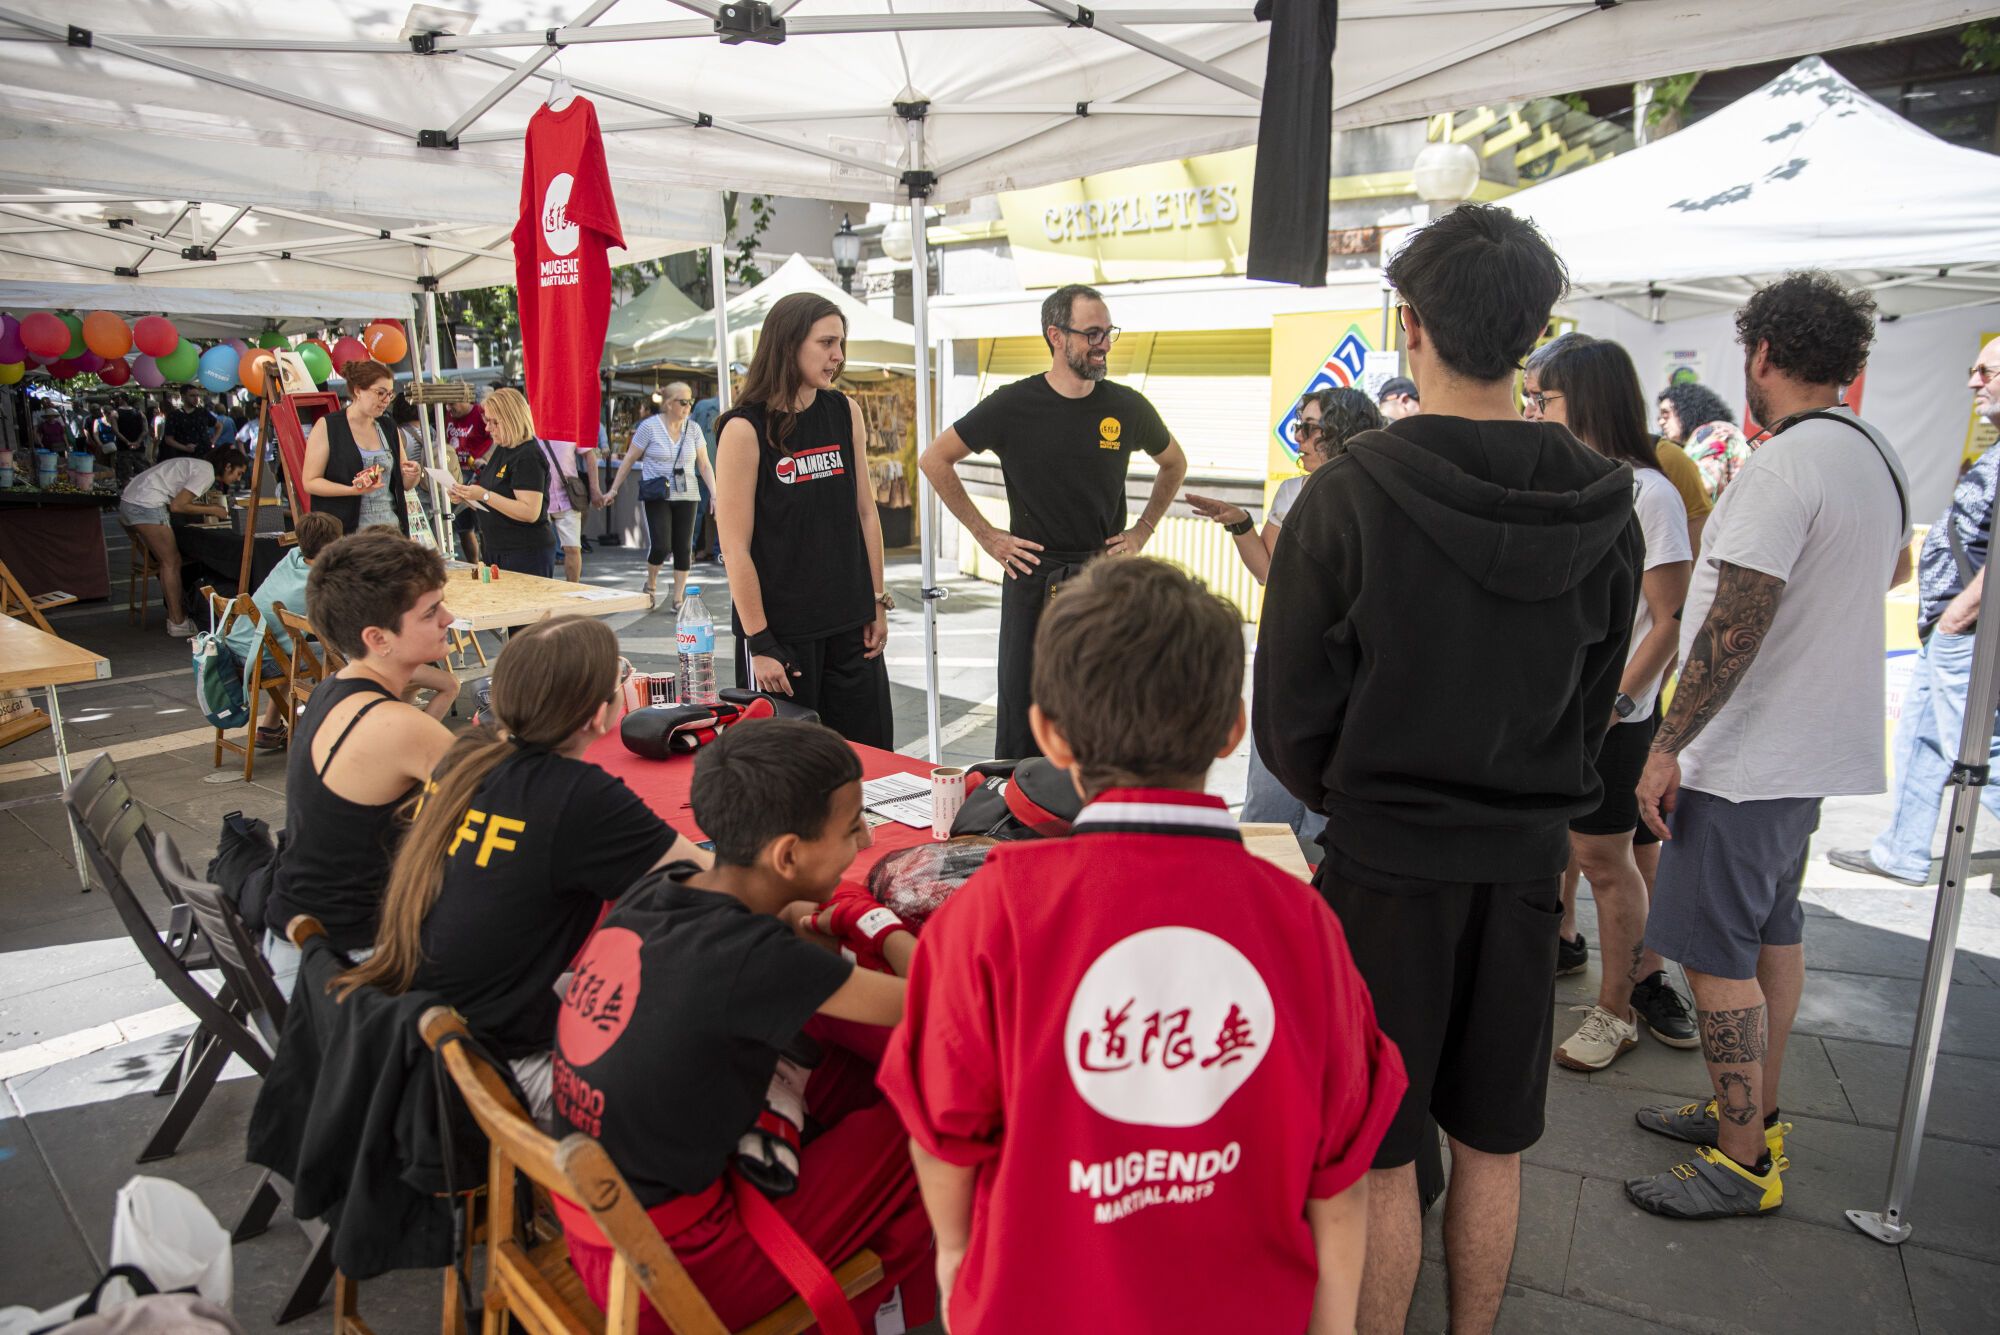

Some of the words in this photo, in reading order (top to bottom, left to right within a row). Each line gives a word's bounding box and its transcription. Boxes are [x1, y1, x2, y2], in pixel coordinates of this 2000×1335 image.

[1042, 183, 1240, 241] CANALETES
[796, 450, 844, 475] MANRESA
[1069, 1141, 1241, 1198] MUGENDO
[1094, 1185, 1163, 1224] MARTIAL
[1164, 1181, 1215, 1204] ARTS
